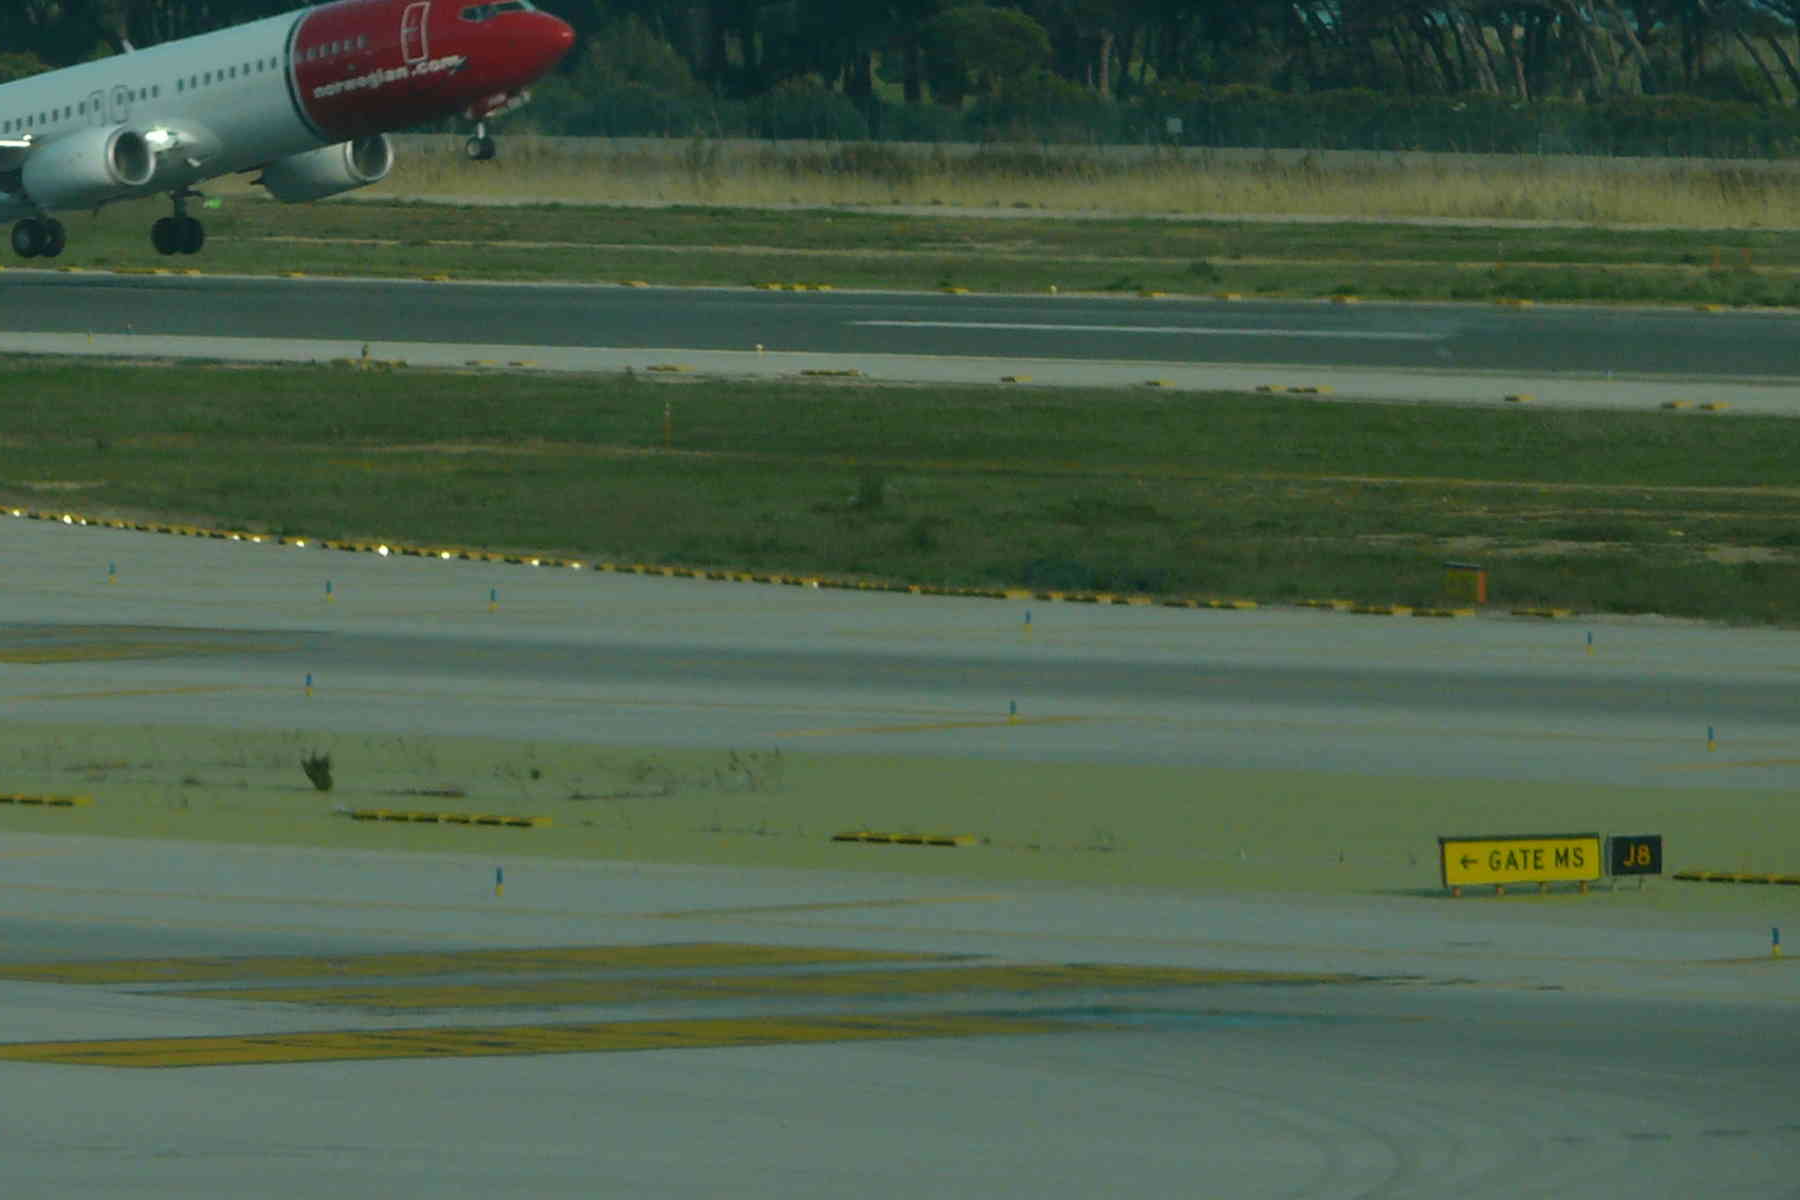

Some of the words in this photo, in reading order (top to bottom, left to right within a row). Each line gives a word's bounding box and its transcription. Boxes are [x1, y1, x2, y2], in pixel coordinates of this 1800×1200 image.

[312, 54, 463, 98] norwegian.com
[1488, 849, 1545, 872] GATE
[1555, 846, 1584, 869] MS
[1623, 842, 1651, 867] J8
